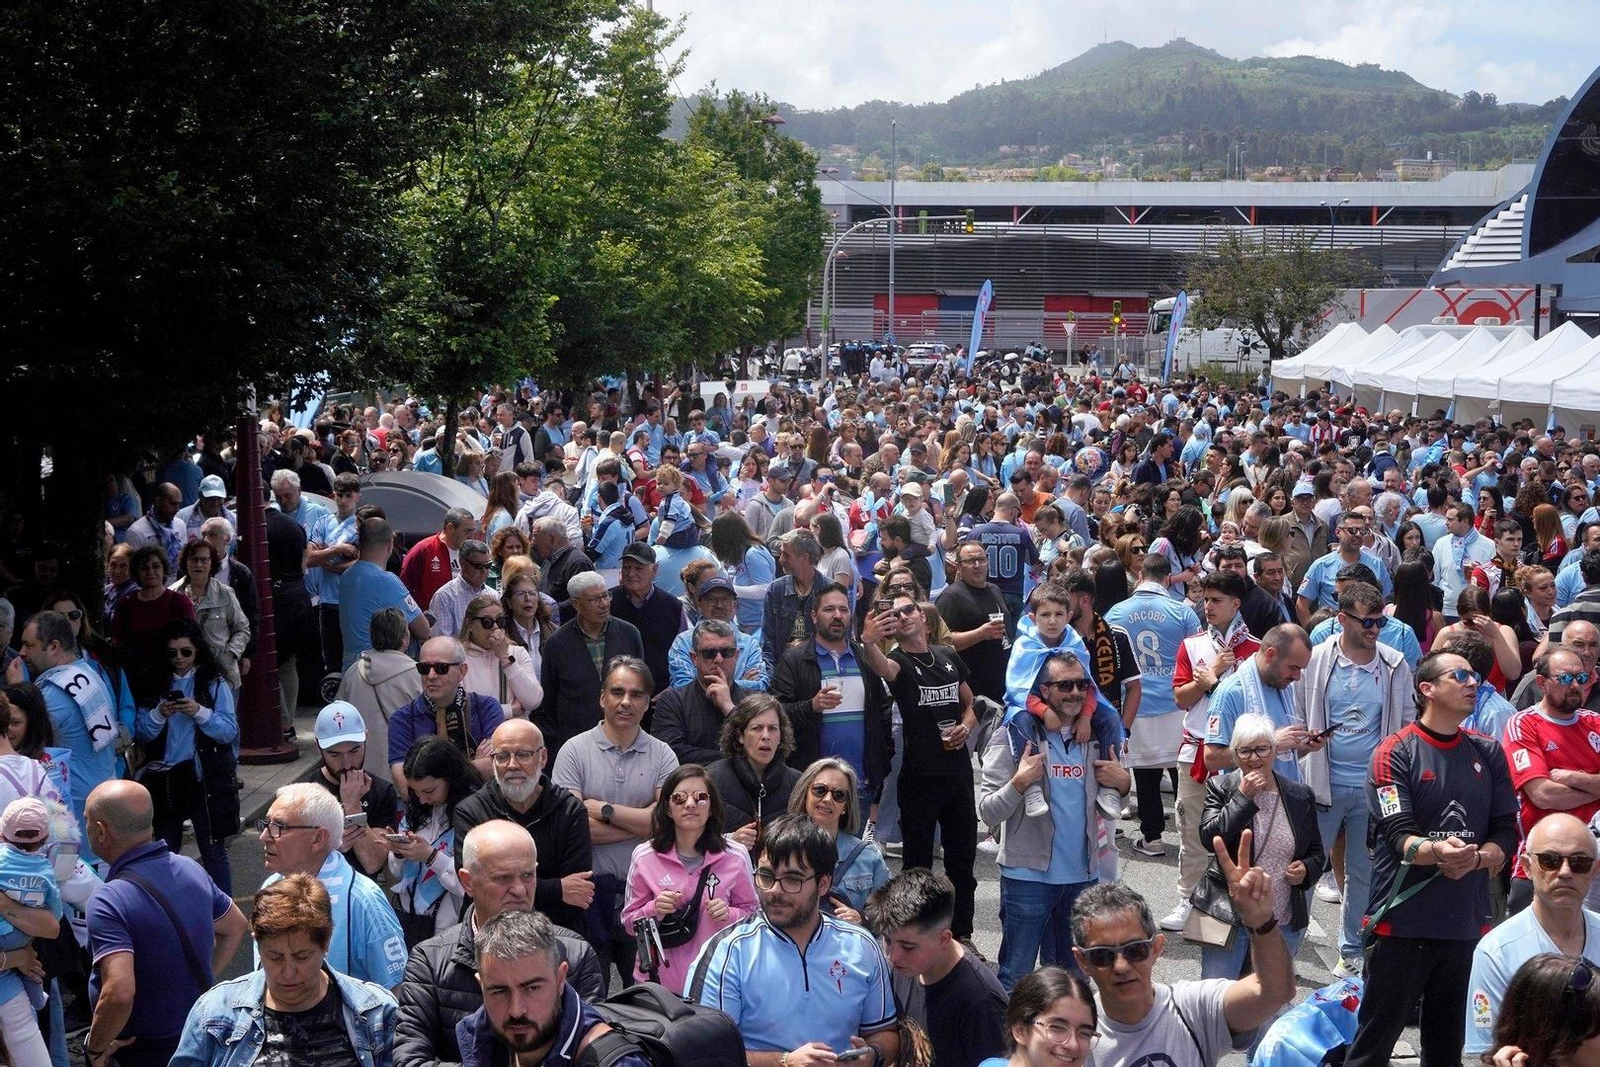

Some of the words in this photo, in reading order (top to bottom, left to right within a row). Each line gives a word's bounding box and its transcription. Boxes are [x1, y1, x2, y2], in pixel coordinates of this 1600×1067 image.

[986, 545, 1018, 578] 10
[1128, 610, 1167, 624] JACOBO
[1136, 629, 1163, 668] 8
[1142, 666, 1175, 676] BANCA
[1383, 803, 1398, 816] LFP
